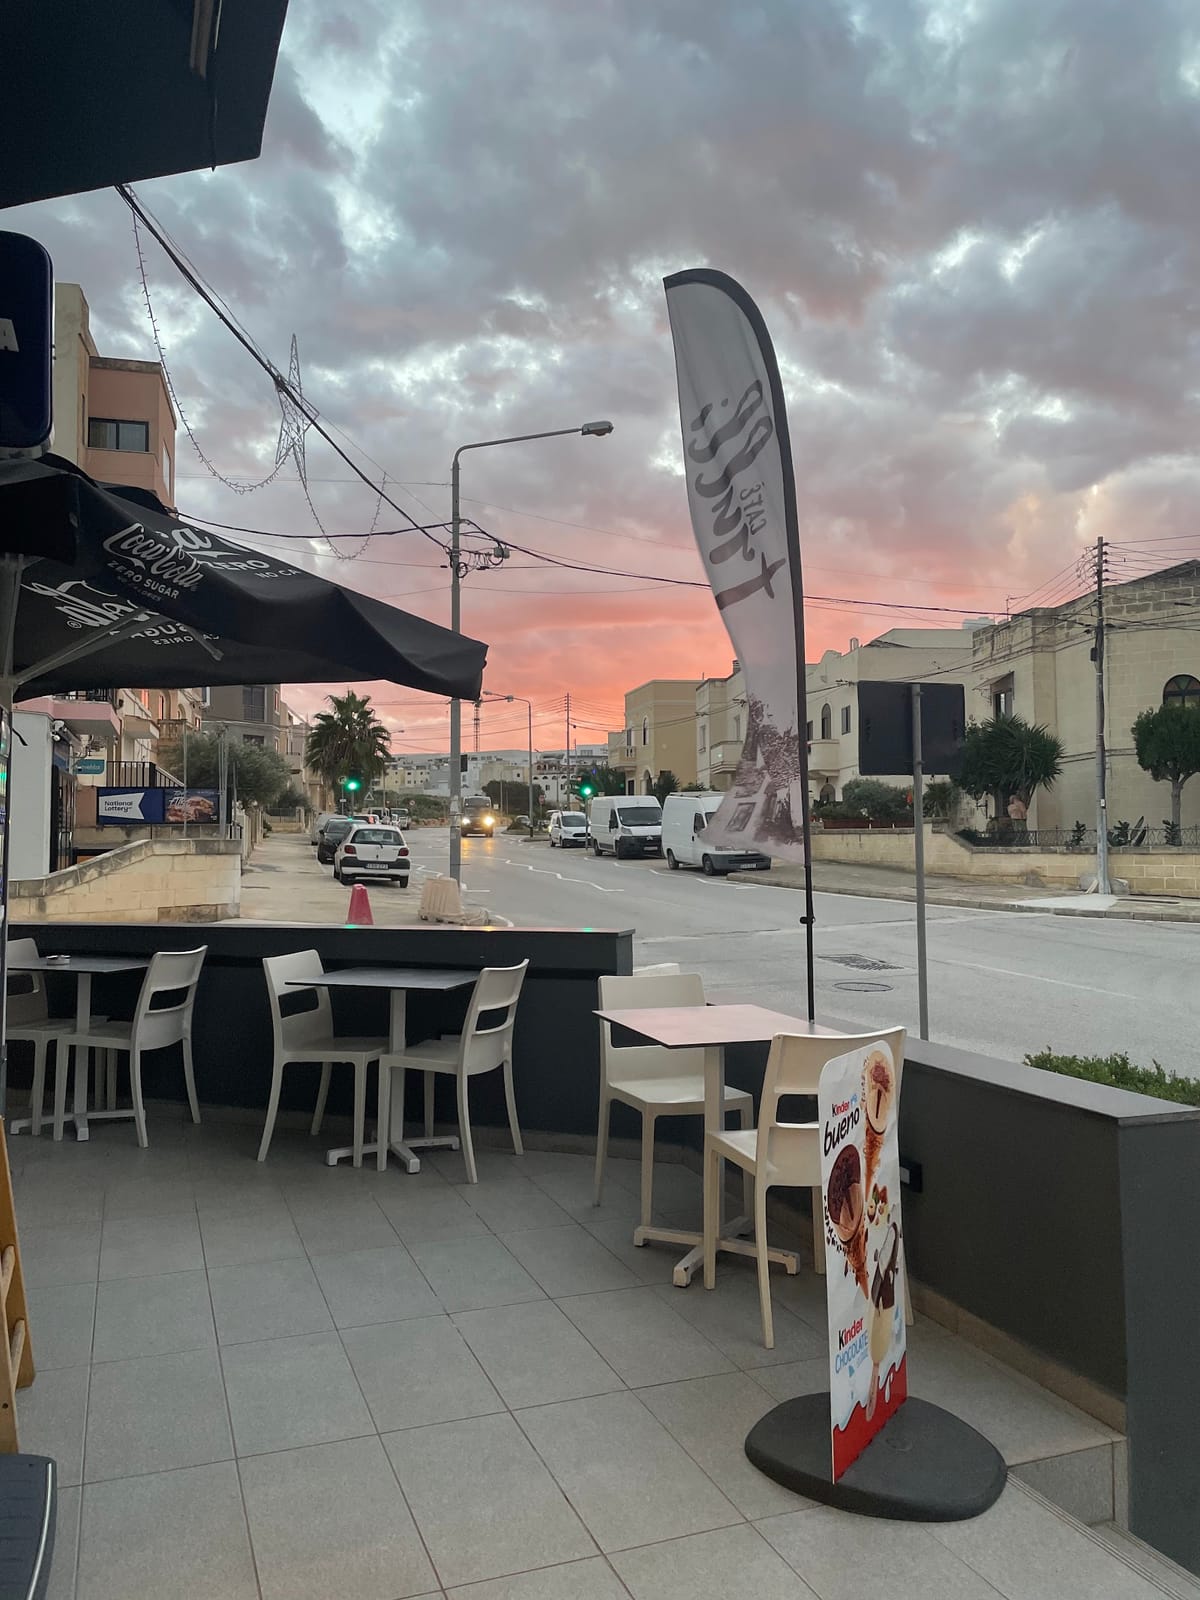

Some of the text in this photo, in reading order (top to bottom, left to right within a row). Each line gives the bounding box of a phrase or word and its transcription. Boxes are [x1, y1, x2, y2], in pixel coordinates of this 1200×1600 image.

[107, 560, 142, 583] ZERO
[143, 578, 180, 600] SUGAR
[823, 1107, 860, 1157] bueno
[835, 1329, 868, 1374] CHOCOLATE
